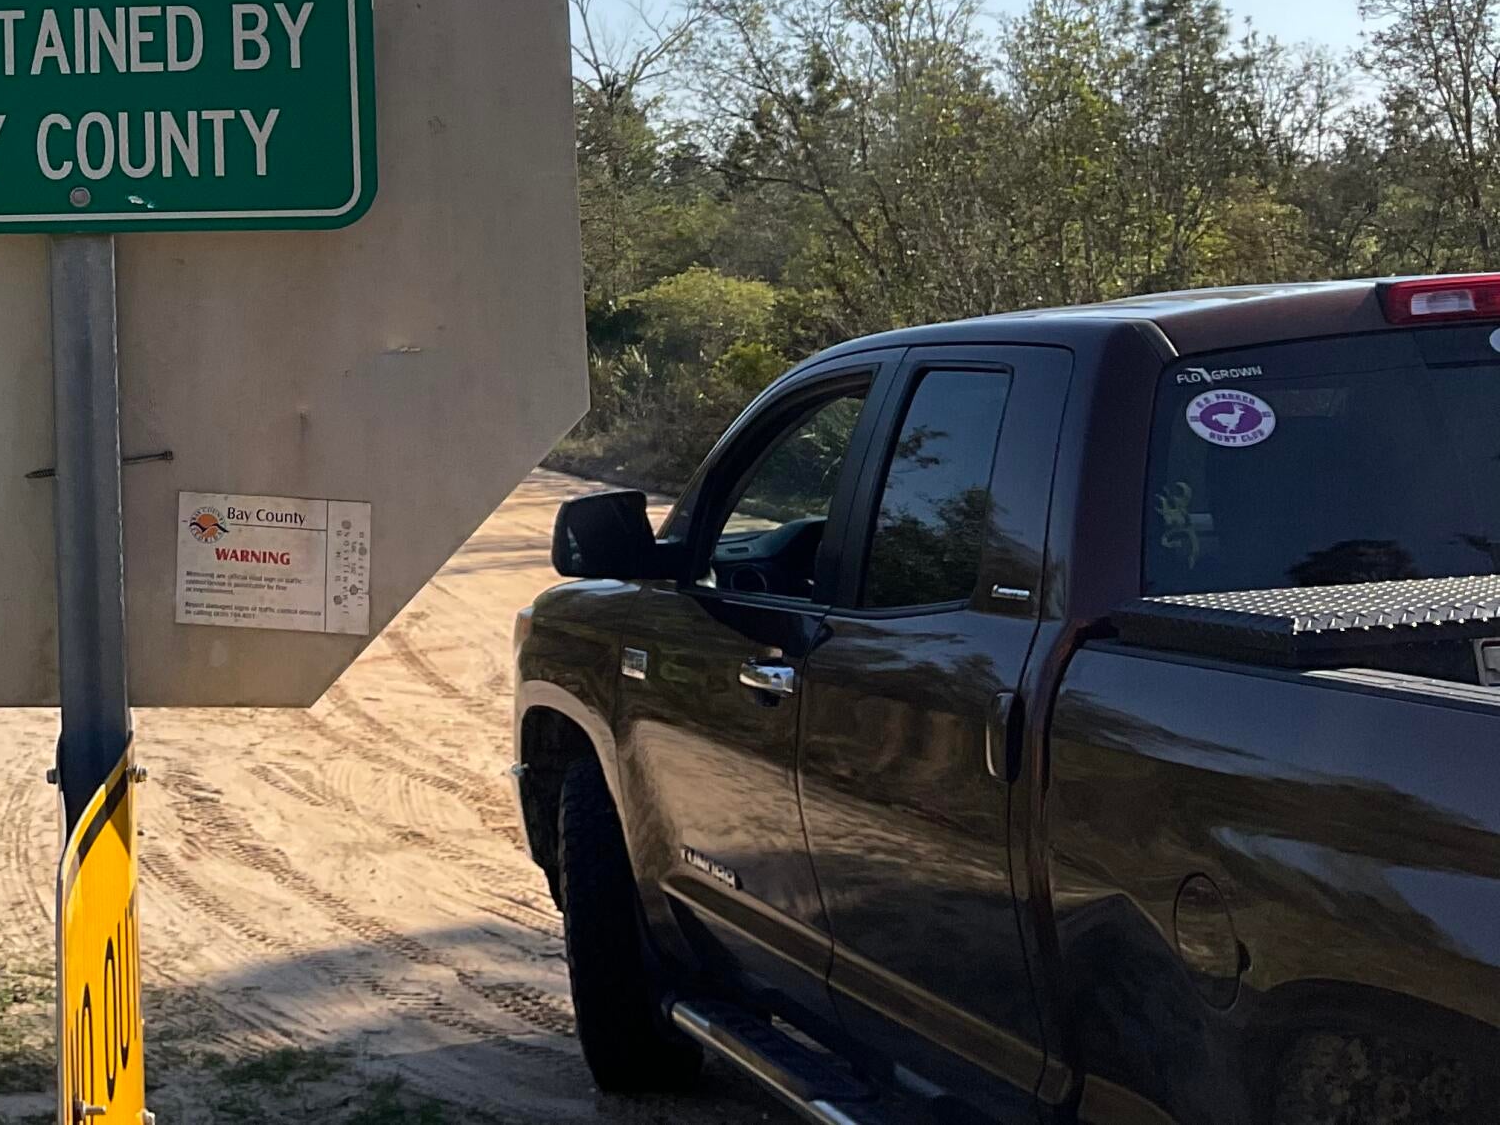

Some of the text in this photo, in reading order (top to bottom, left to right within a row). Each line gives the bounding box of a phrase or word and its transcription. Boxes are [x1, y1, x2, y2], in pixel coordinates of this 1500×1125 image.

[232, 2, 314, 70] BY
[36, 109, 280, 181] COUNTY
[1211, 365, 1263, 380] GROWN
[227, 506, 250, 522] Bay
[256, 508, 306, 526] County
[215, 547, 291, 565] WARNING
